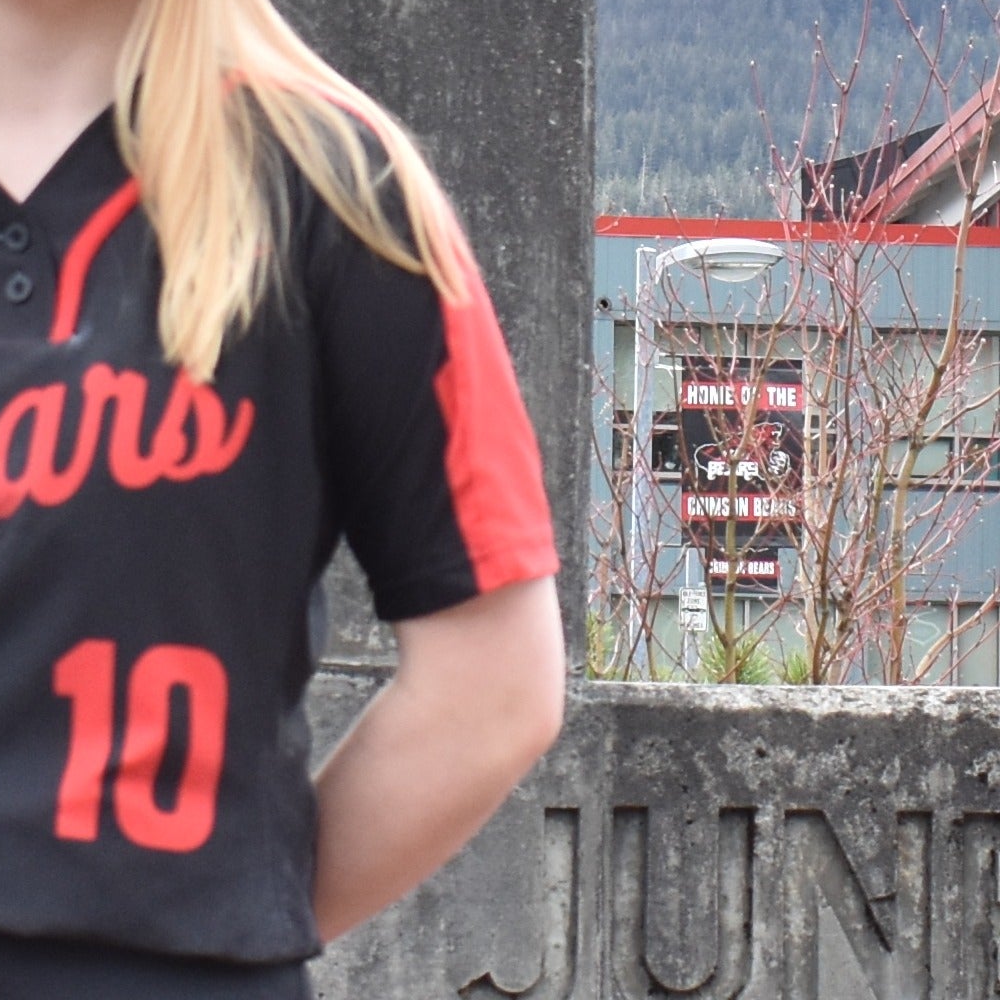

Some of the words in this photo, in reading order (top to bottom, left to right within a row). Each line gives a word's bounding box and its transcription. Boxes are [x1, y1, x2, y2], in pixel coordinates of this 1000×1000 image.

[687, 385, 735, 405] HOME
[767, 386, 797, 407] THE
[687, 496, 749, 517] CRIMSN
[52, 638, 229, 853] 10
